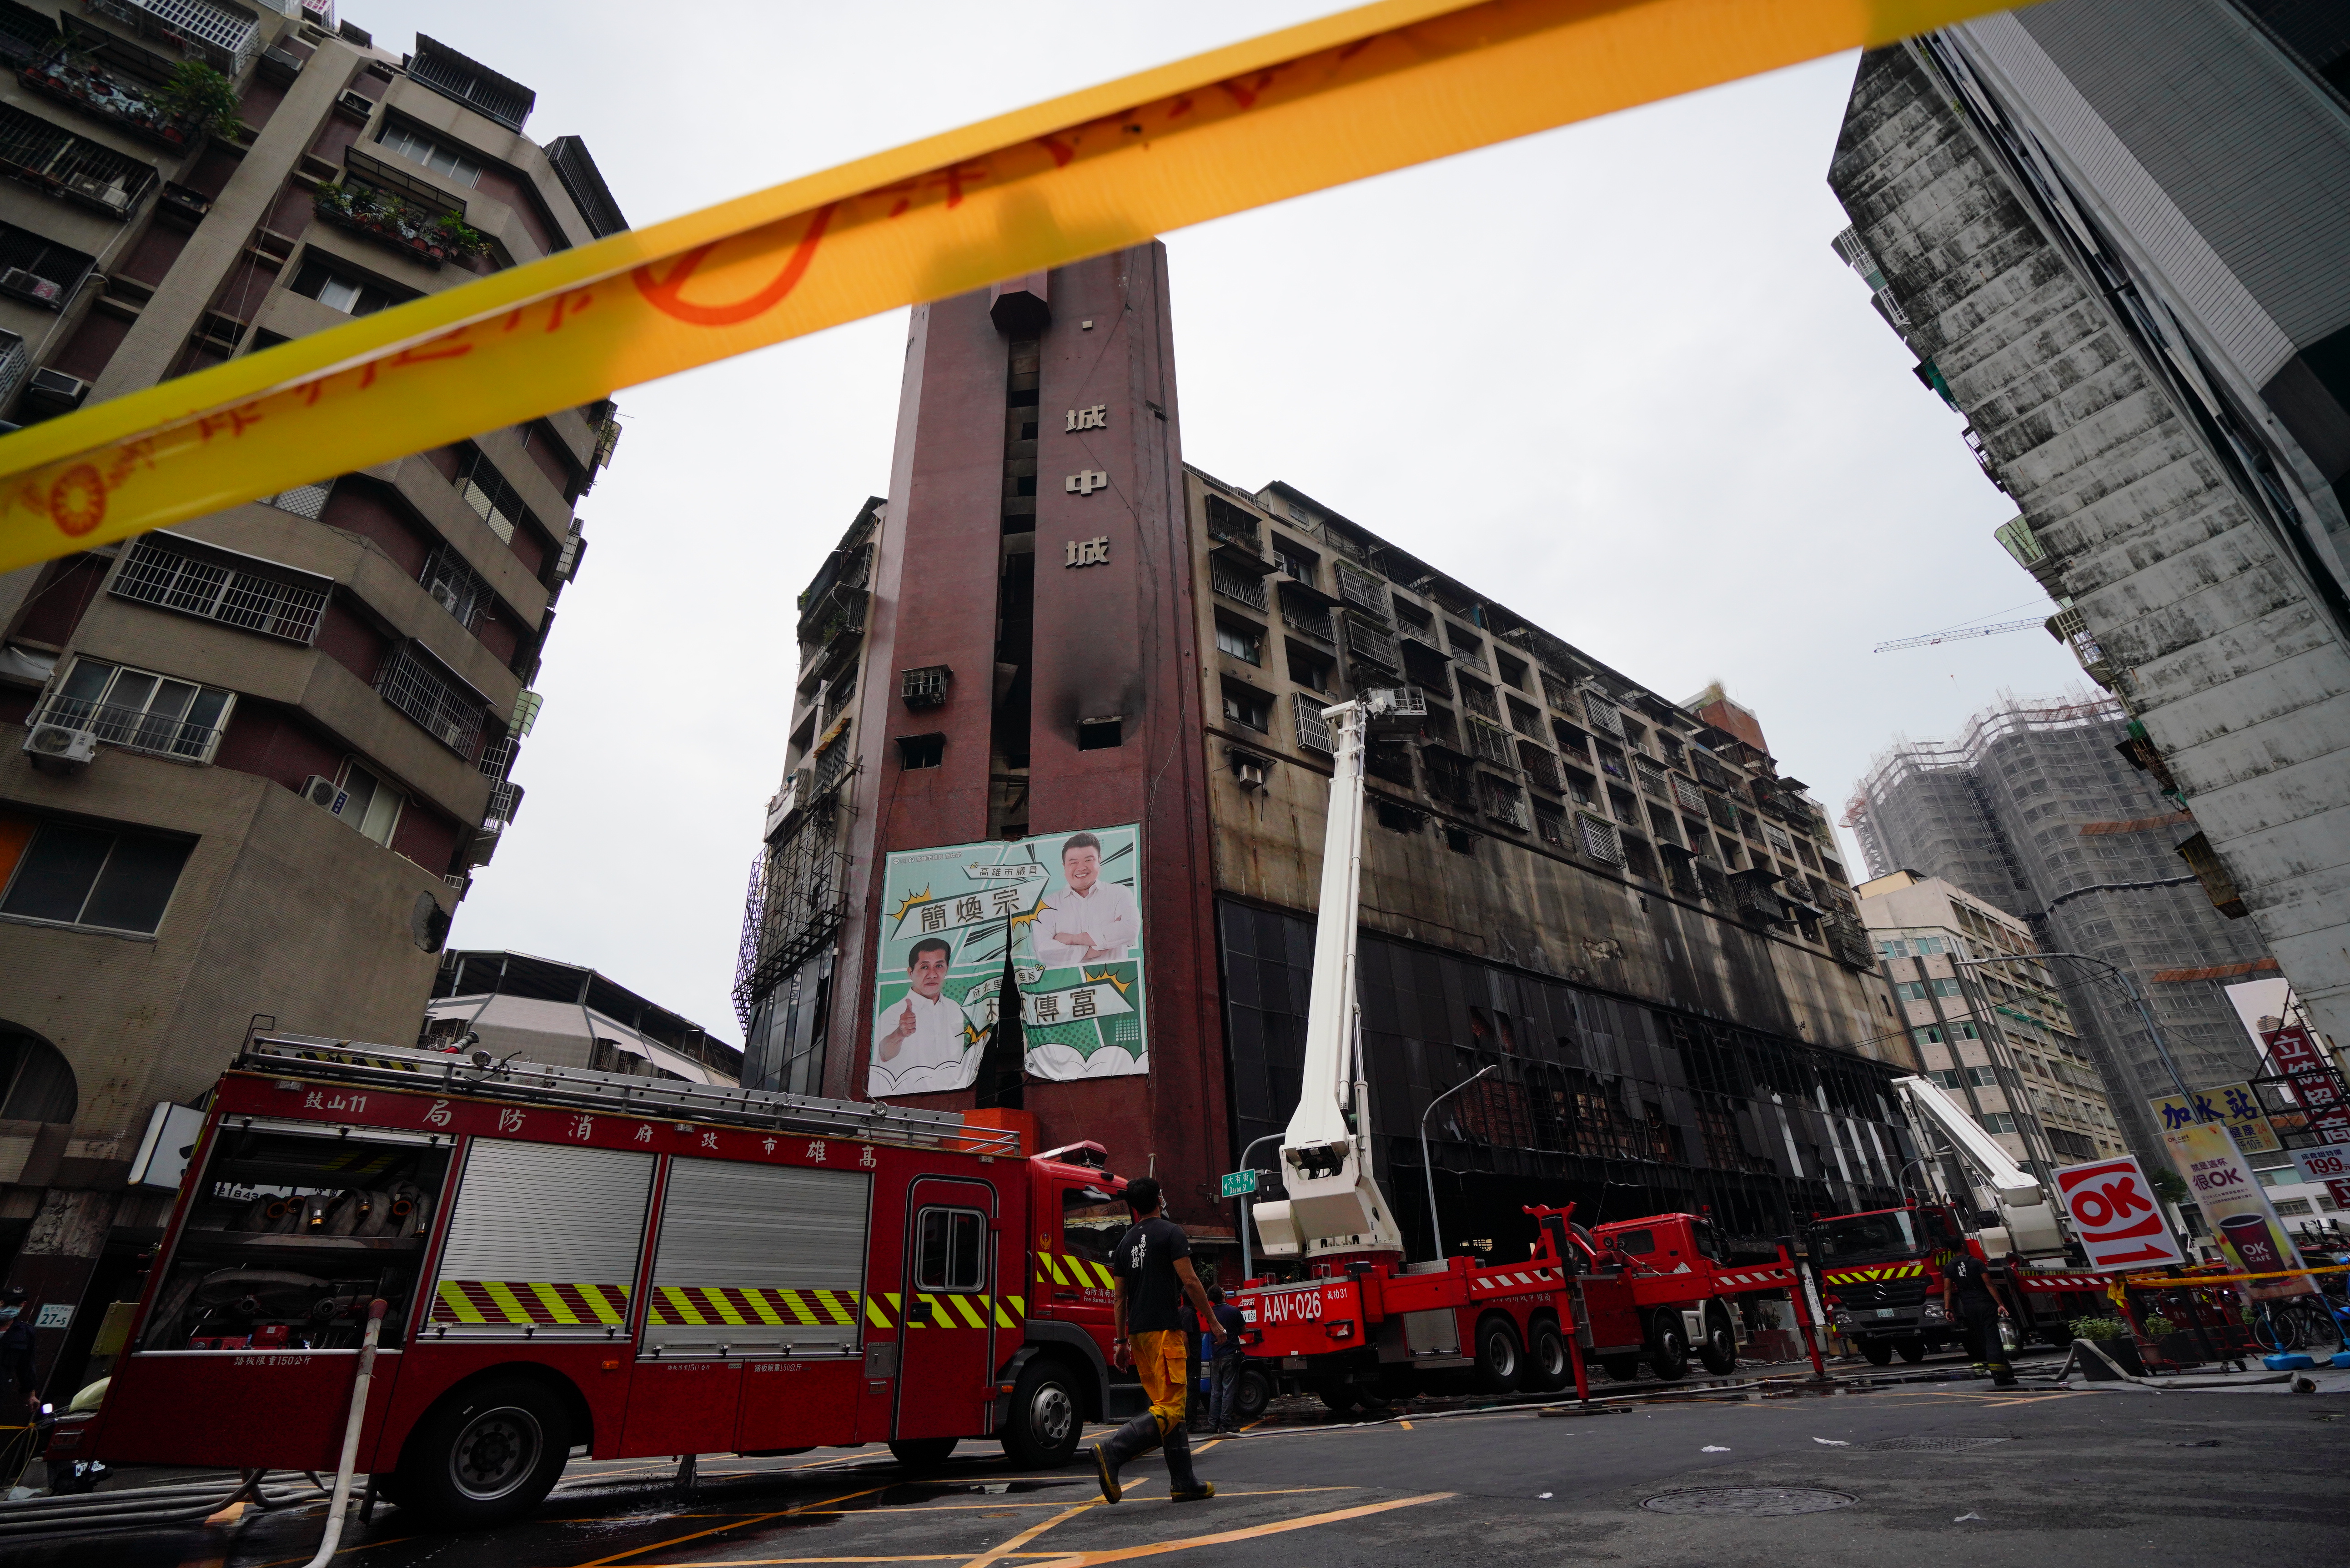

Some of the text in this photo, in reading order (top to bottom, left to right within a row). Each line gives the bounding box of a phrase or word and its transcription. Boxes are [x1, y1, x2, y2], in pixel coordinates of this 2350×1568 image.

[1066, 404, 1109, 568] 城中城
[979, 866, 1037, 877] 高雄市議員
[921, 889, 1020, 932] 簡煥宗
[303, 1091, 367, 1113] 鼓山11
[2161, 1088, 2259, 1130] 加水站
[2255, 1123, 2268, 1134] 24
[2263, 1136, 2273, 1147] H
[2190, 1158, 2228, 1172] 就是這杯
[1228, 1172, 1249, 1186] 大有街
[2193, 1168, 2244, 1191] 很OK
[1229, 1186, 1241, 1194] Dayou
[2071, 1177, 2152, 1227] OK
[2242, 1241, 2268, 1255] OK
[2249, 1252, 2271, 1263] CAFÉ
[1327, 1288, 1347, 1300] 成功31
[1264, 1291, 1322, 1322] AAV-026
[40, 1314, 66, 1325] 27-5
[234, 1356, 312, 1366] 踏板限重150公斤
[754, 1364, 802, 1372] 踏板限重150公斤
